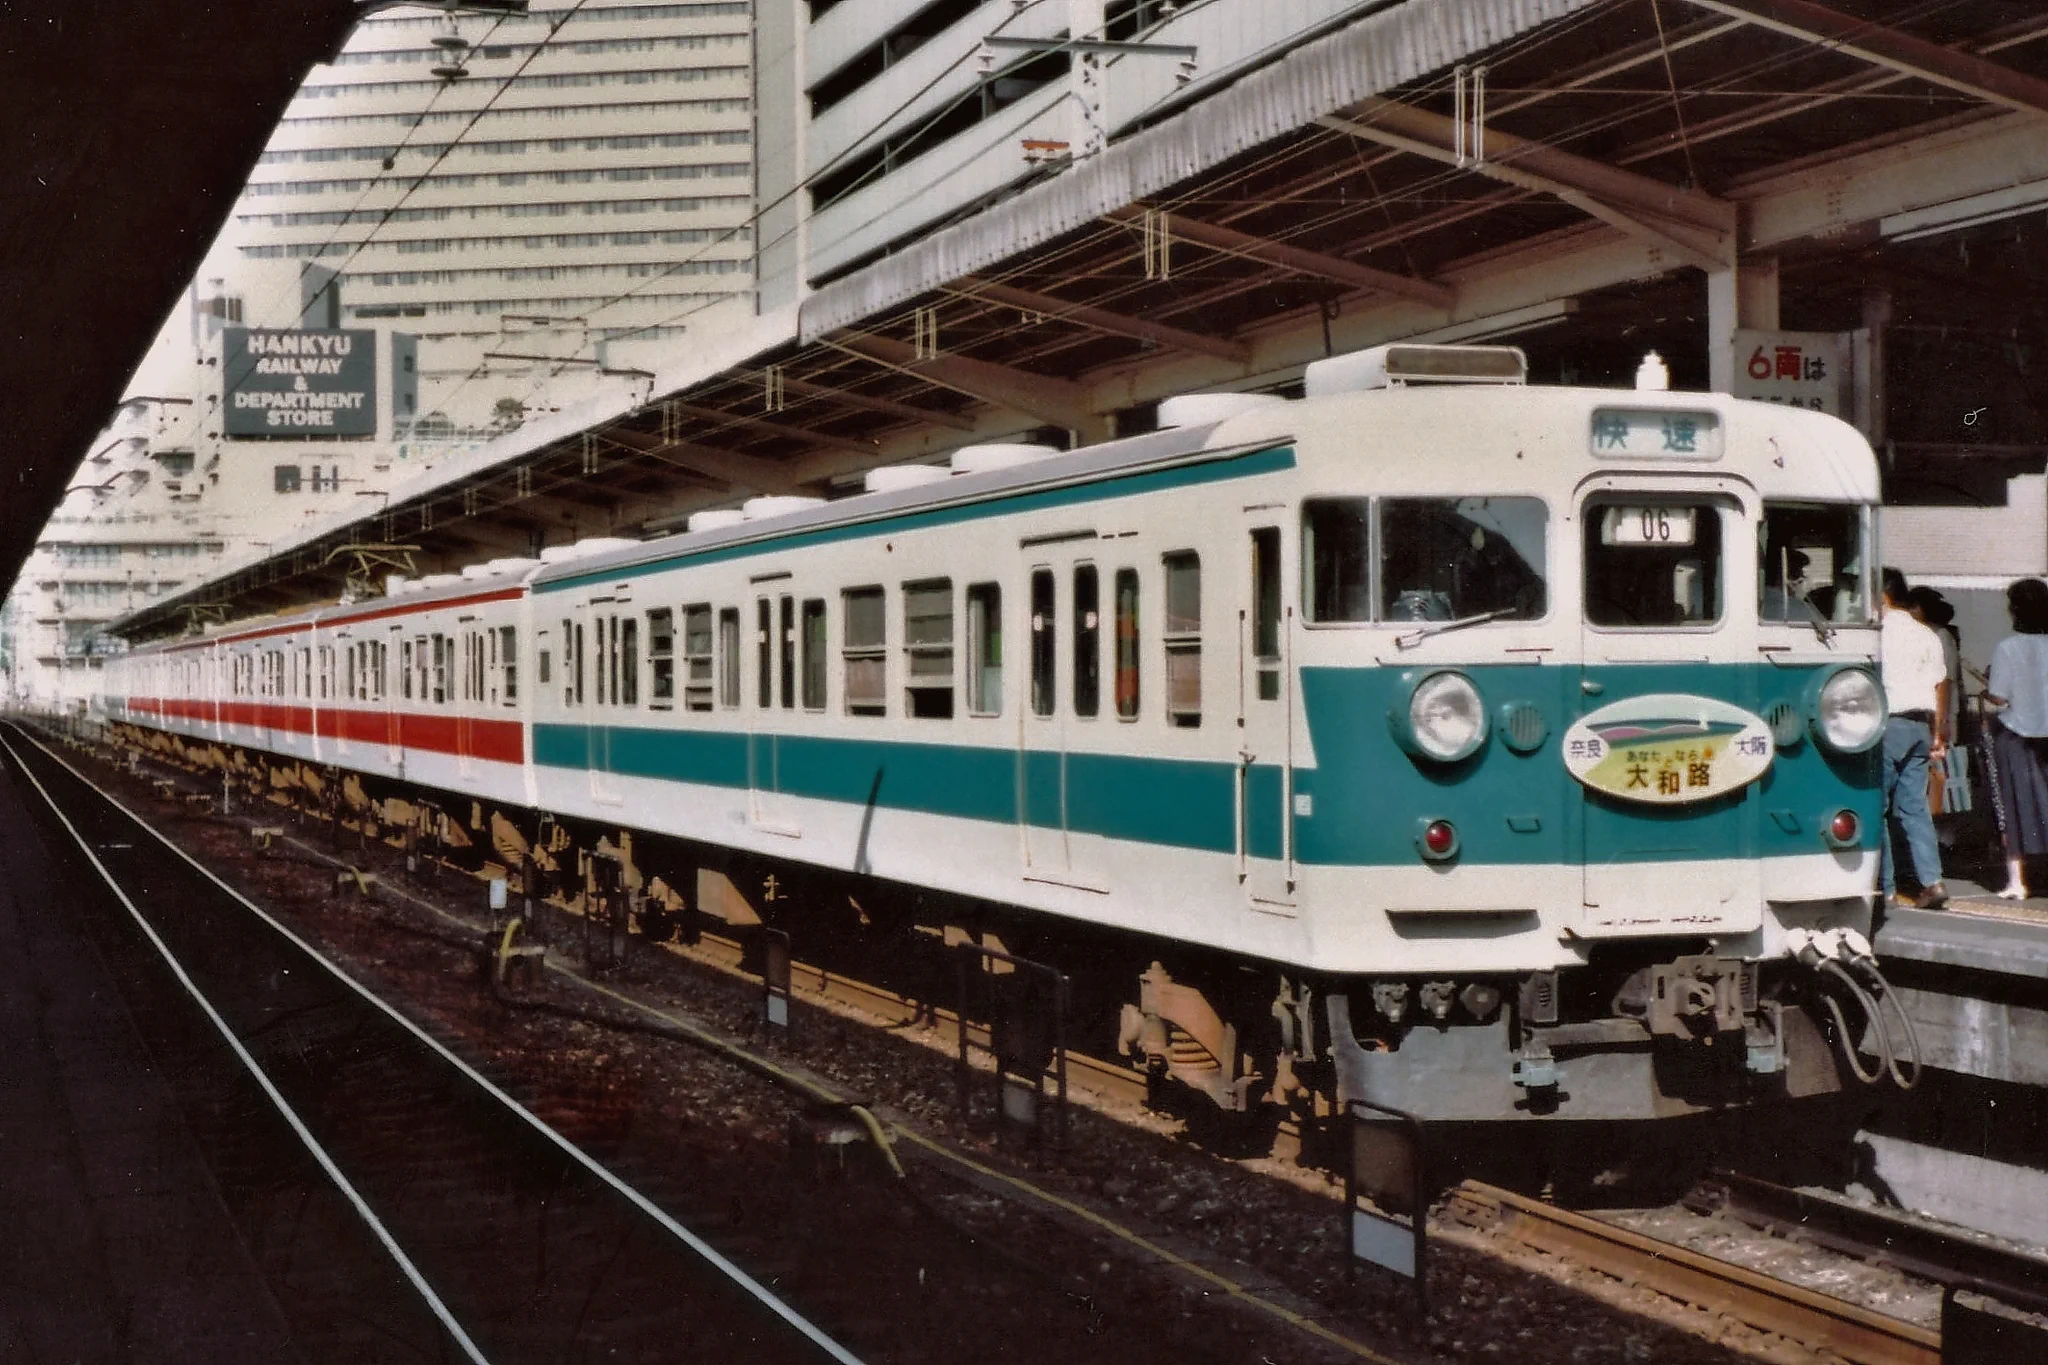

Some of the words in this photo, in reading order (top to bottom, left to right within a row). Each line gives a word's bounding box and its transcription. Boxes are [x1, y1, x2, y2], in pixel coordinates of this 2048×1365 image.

[247, 334, 352, 355] HANKYU
[255, 358, 344, 374] RAILWAY
[1747, 345, 1827, 381] 6両は
[293, 375, 308, 391] &
[234, 392, 365, 408] DEPARTMENT
[266, 410, 335, 426] STORE
[1594, 416, 1696, 452] 快速
[1642, 508, 1670, 541] 06
[1570, 739, 1601, 760] 奈良
[1735, 736, 1767, 756] 大阪
[1627, 762, 1710, 795] 大和路
